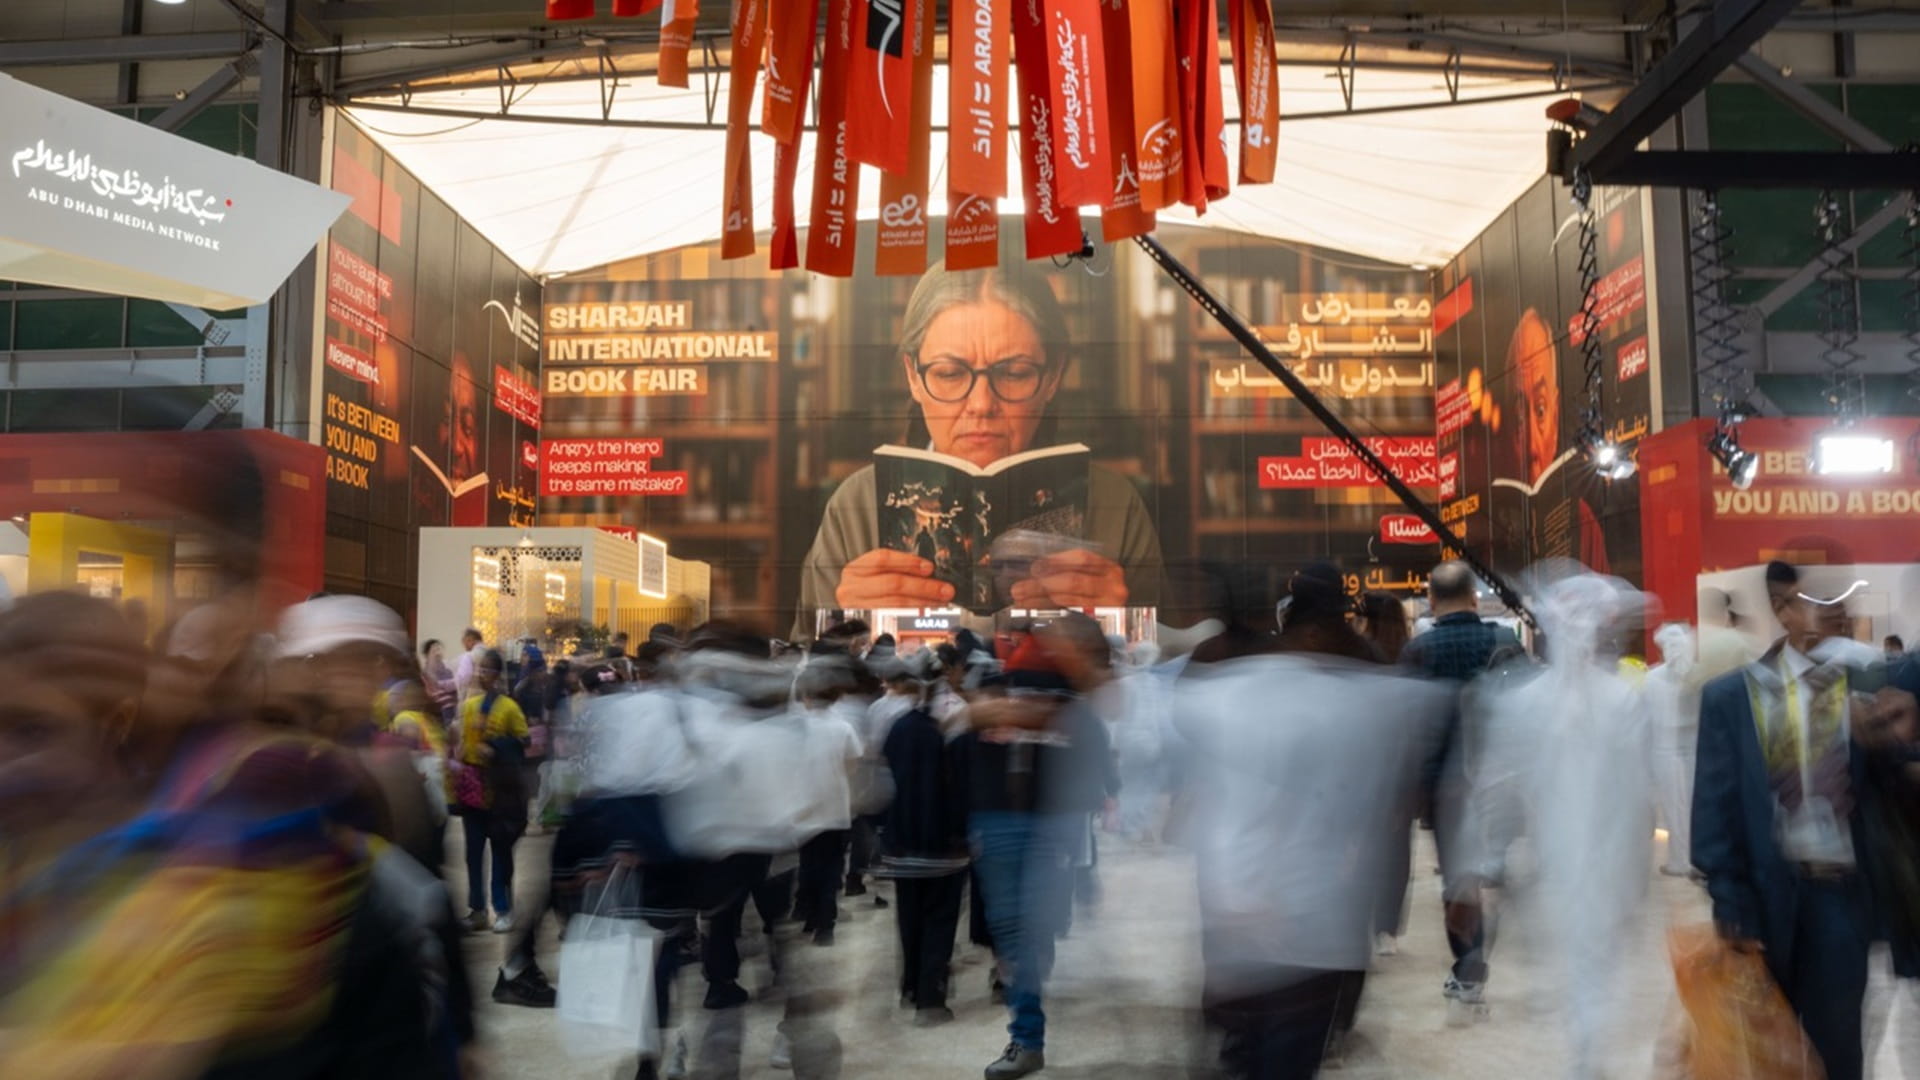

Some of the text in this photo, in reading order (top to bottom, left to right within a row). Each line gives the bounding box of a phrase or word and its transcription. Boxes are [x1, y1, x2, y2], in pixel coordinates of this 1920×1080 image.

[28, 187, 220, 251] ABU DHABI MEDIA NETWORK
[549, 304, 686, 328] SHARJAH
[548, 335, 772, 361] INTERNATIONAL
[547, 369, 628, 393] BOOK
[633, 368, 698, 392] FAIR
[1340, 362, 1434, 399] الدولي
[347, 402, 400, 445] BETWEEN
[326, 424, 377, 463] YOU AND
[549, 441, 595, 456] Angry,
[598, 441, 622, 455] the
[625, 440, 660, 455] hero
[326, 455, 369, 490] A BOOK
[549, 460, 647, 475] keeps making
[549, 476, 684, 492] the same mistake?
[1714, 490, 1772, 515] YOU
[1777, 490, 1840, 514] AND
[1846, 490, 1868, 514] A
